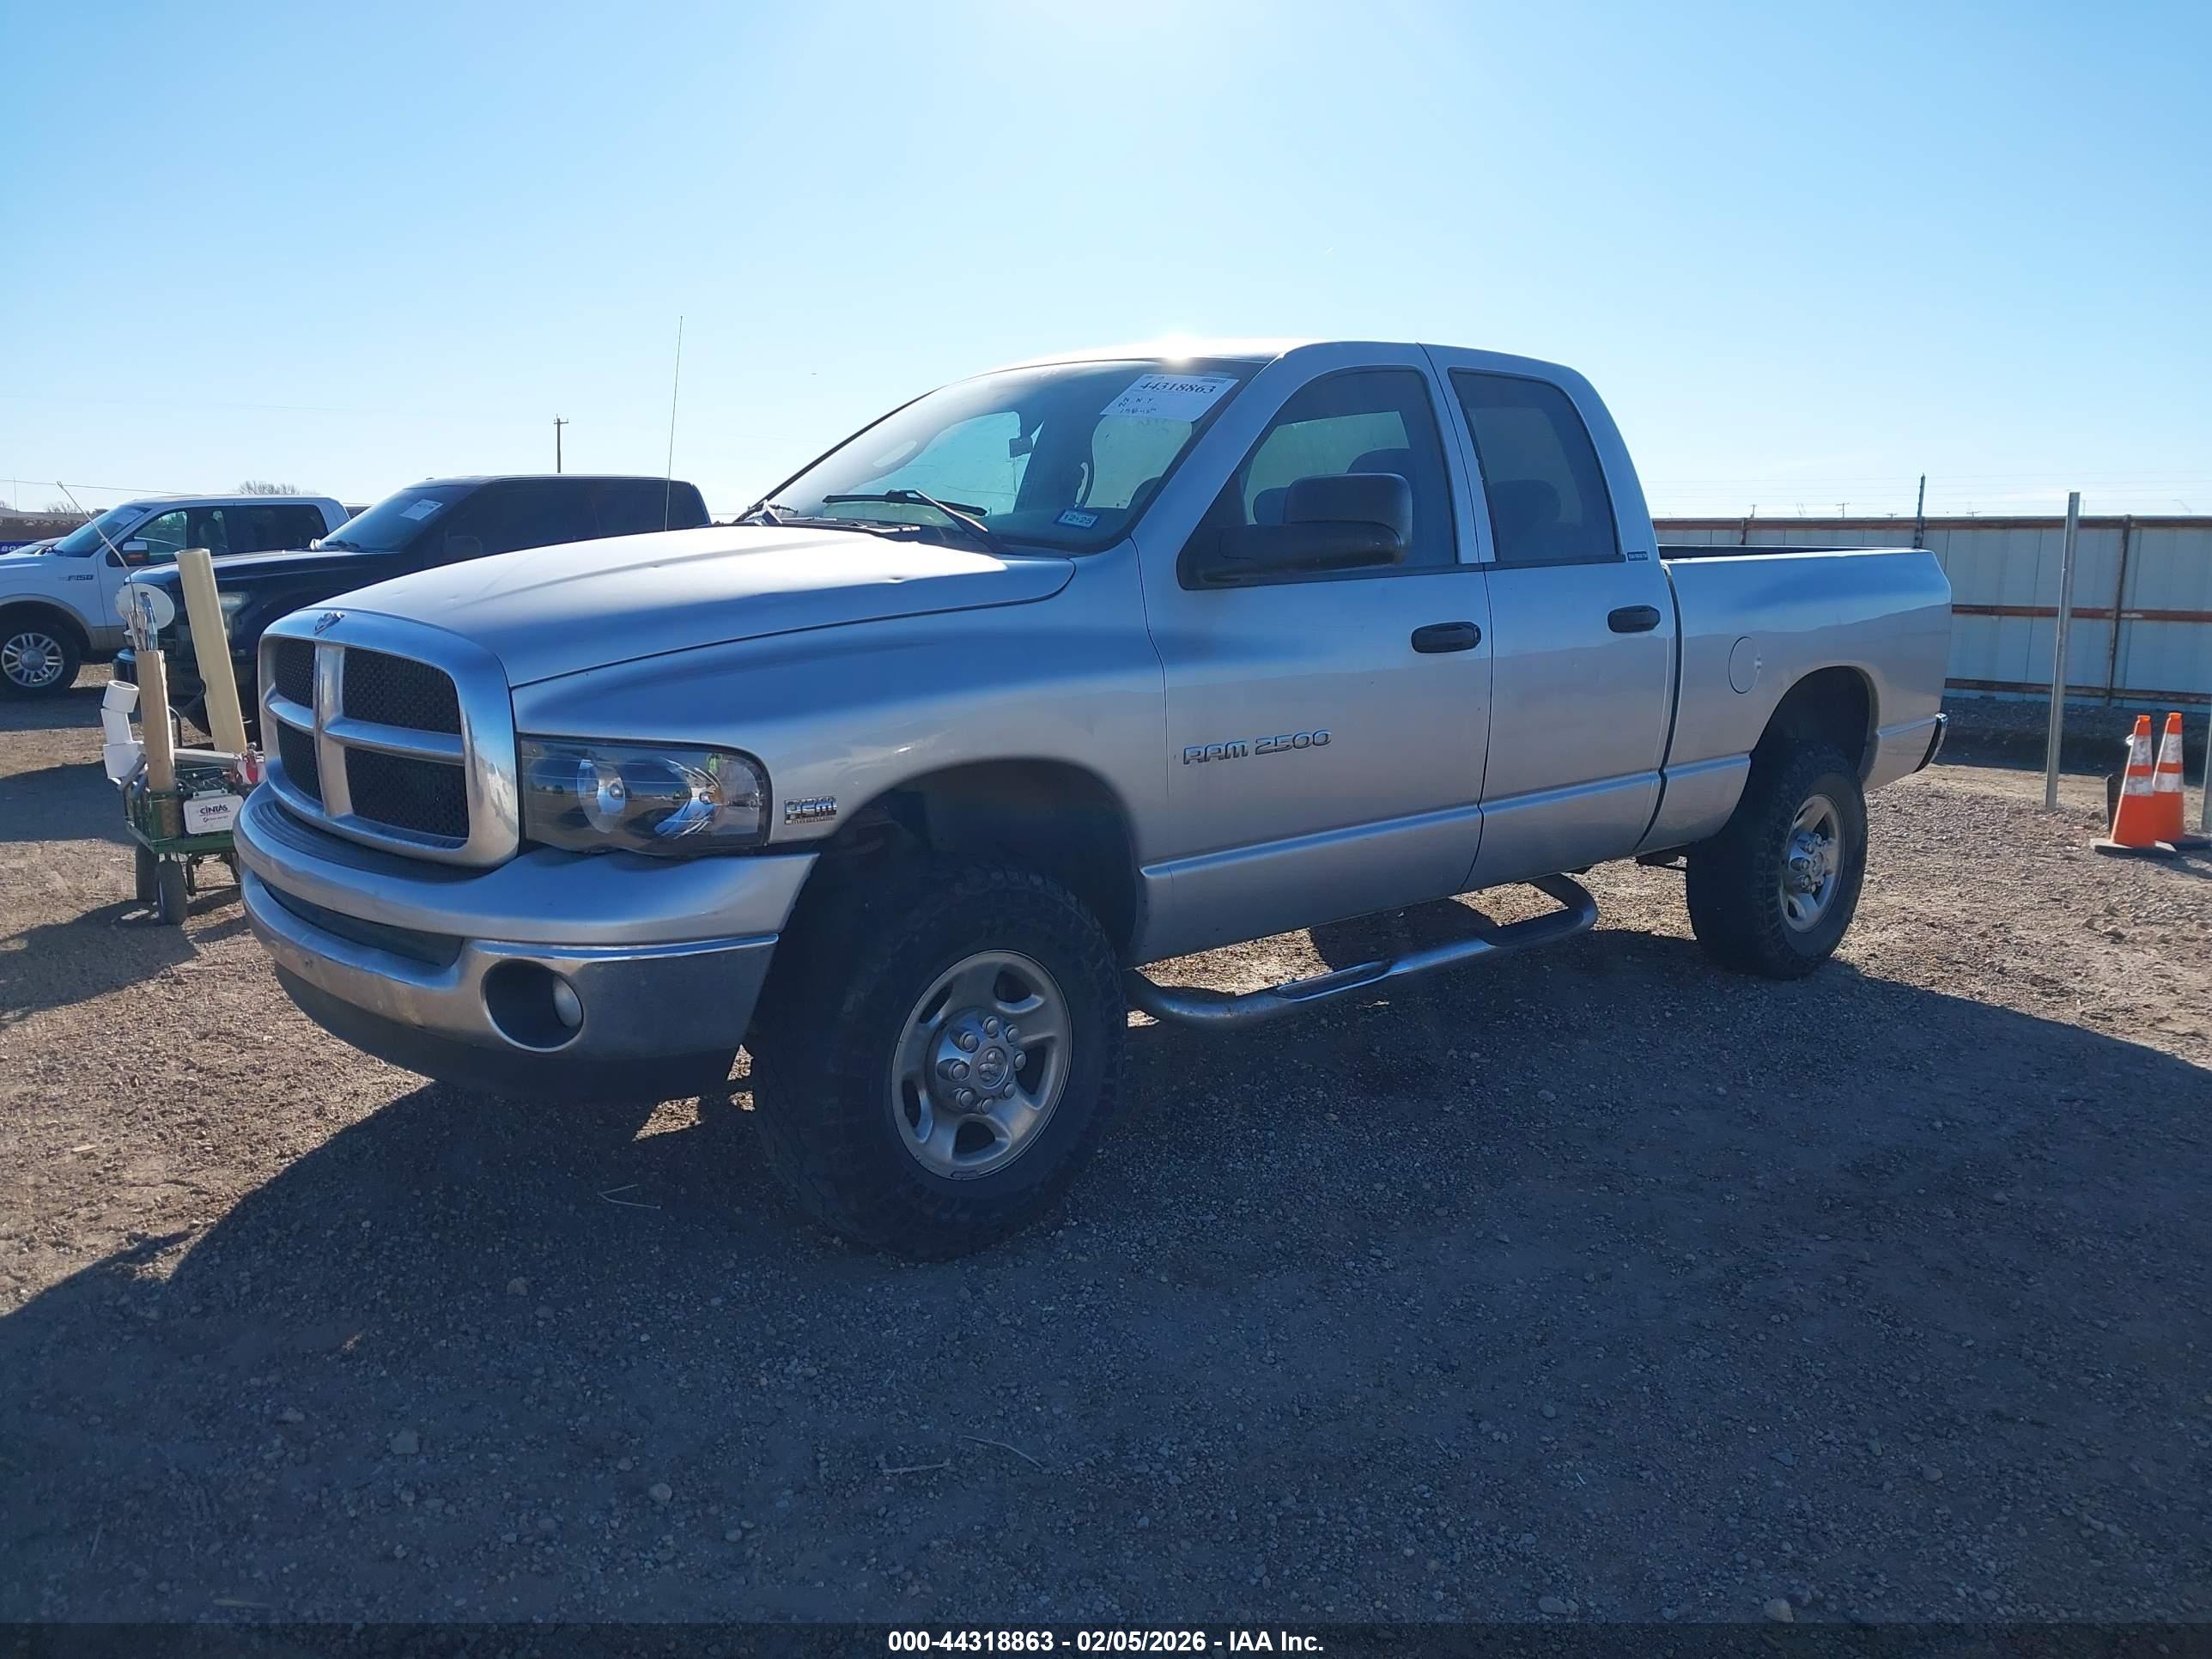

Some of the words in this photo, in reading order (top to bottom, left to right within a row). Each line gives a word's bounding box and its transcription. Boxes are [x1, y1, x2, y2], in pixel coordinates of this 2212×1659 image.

[1140, 381, 1217, 394] 44318863
[1183, 739, 1250, 765] RAM
[1255, 729, 1333, 756] 2500
